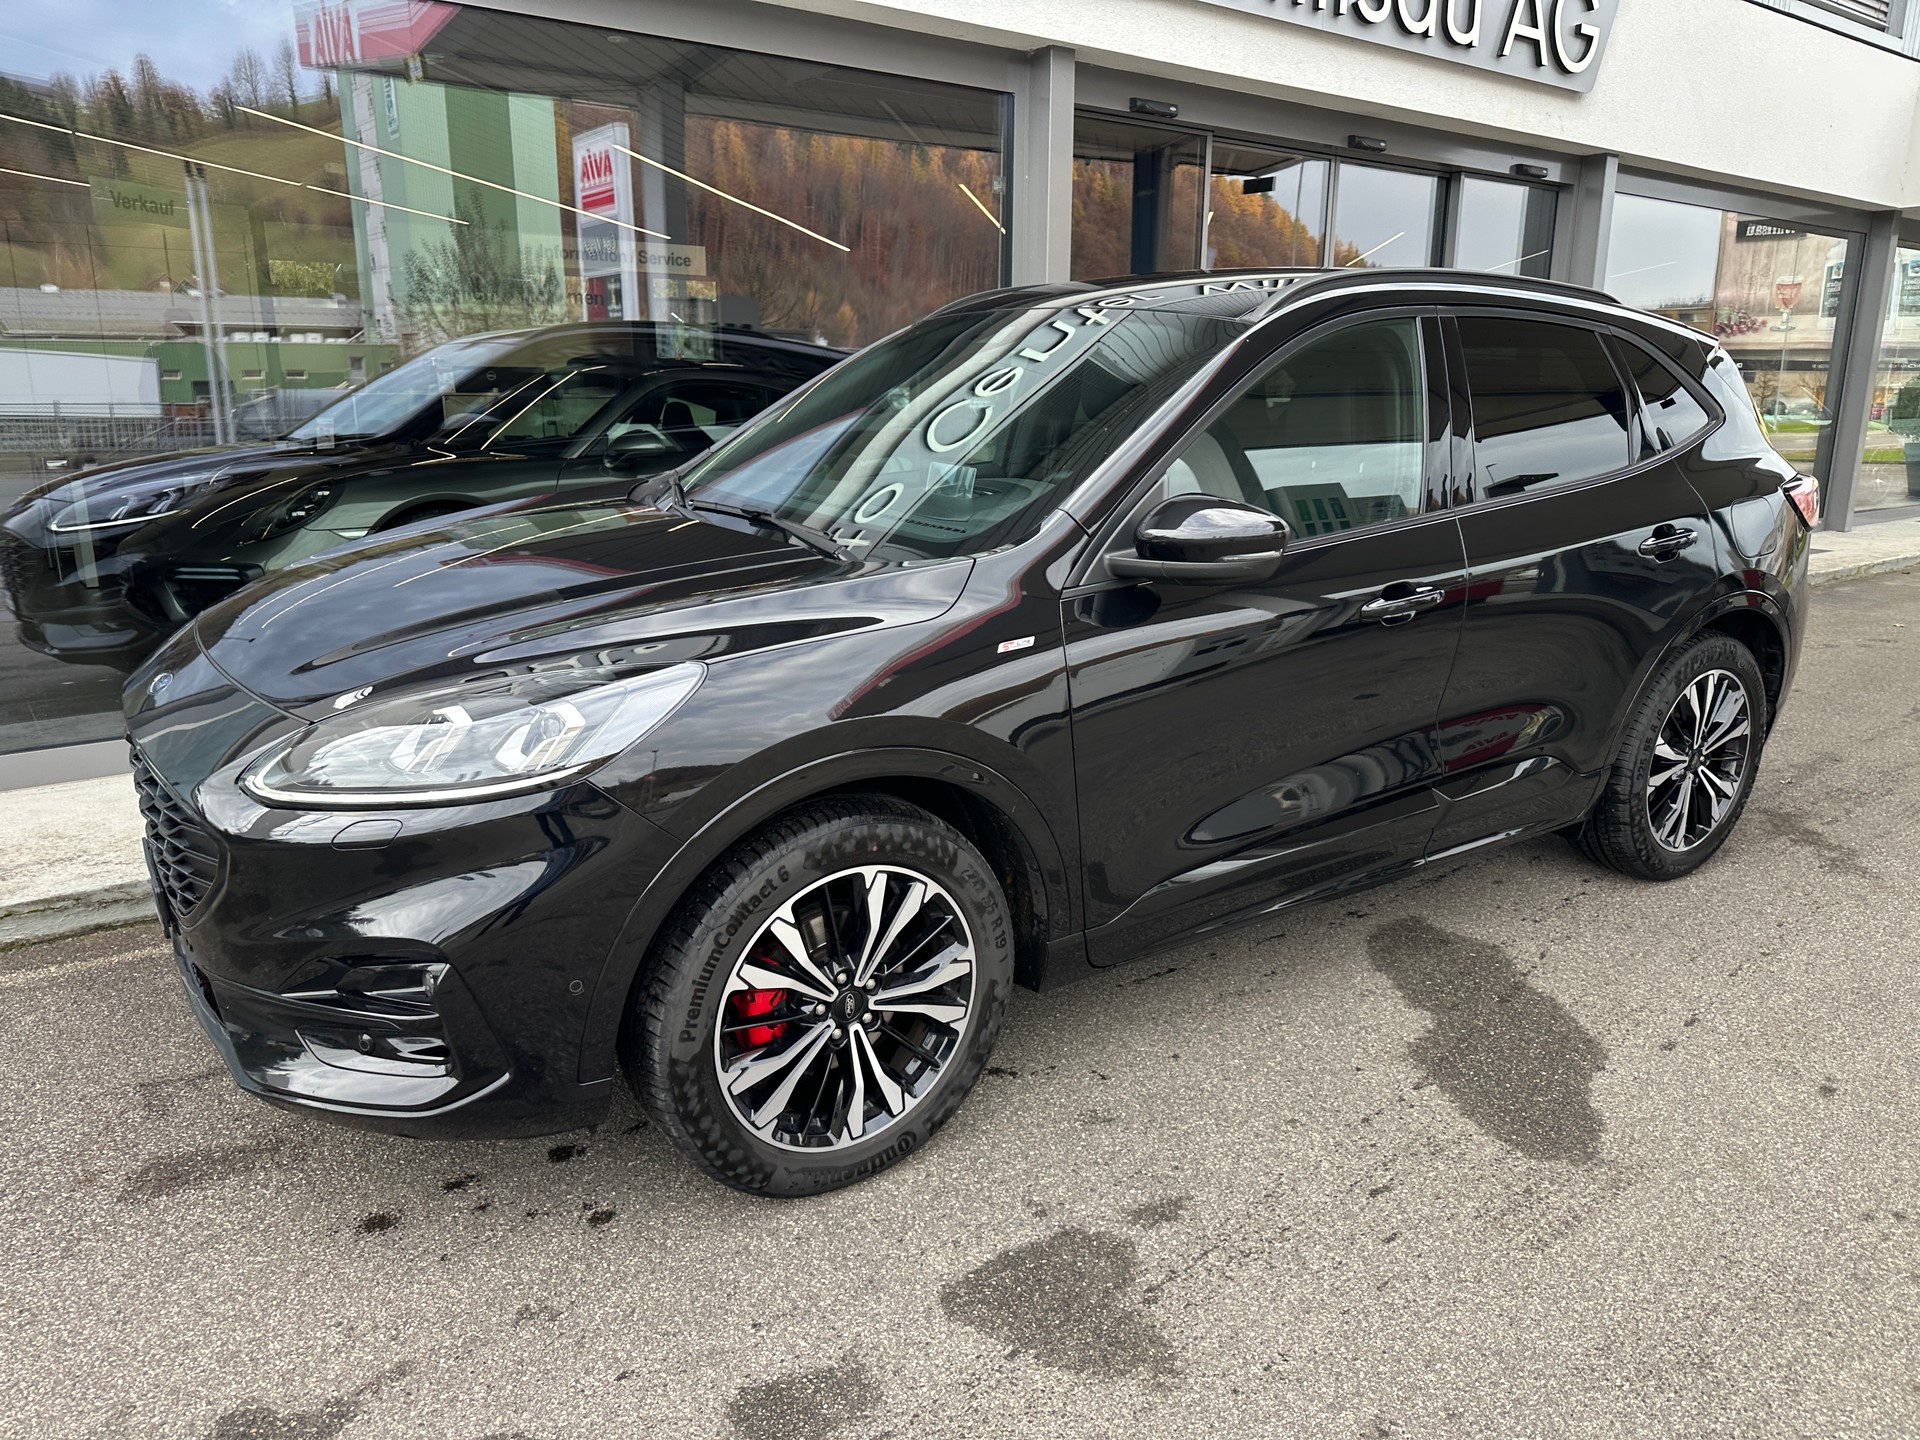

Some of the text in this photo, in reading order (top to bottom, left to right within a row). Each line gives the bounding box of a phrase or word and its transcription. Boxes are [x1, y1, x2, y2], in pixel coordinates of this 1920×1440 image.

[1499, 0, 1601, 73] AG
[109, 190, 175, 216] Verkauf
[638, 250, 692, 267] Service
[678, 864, 791, 1044] PremiumContact 6
